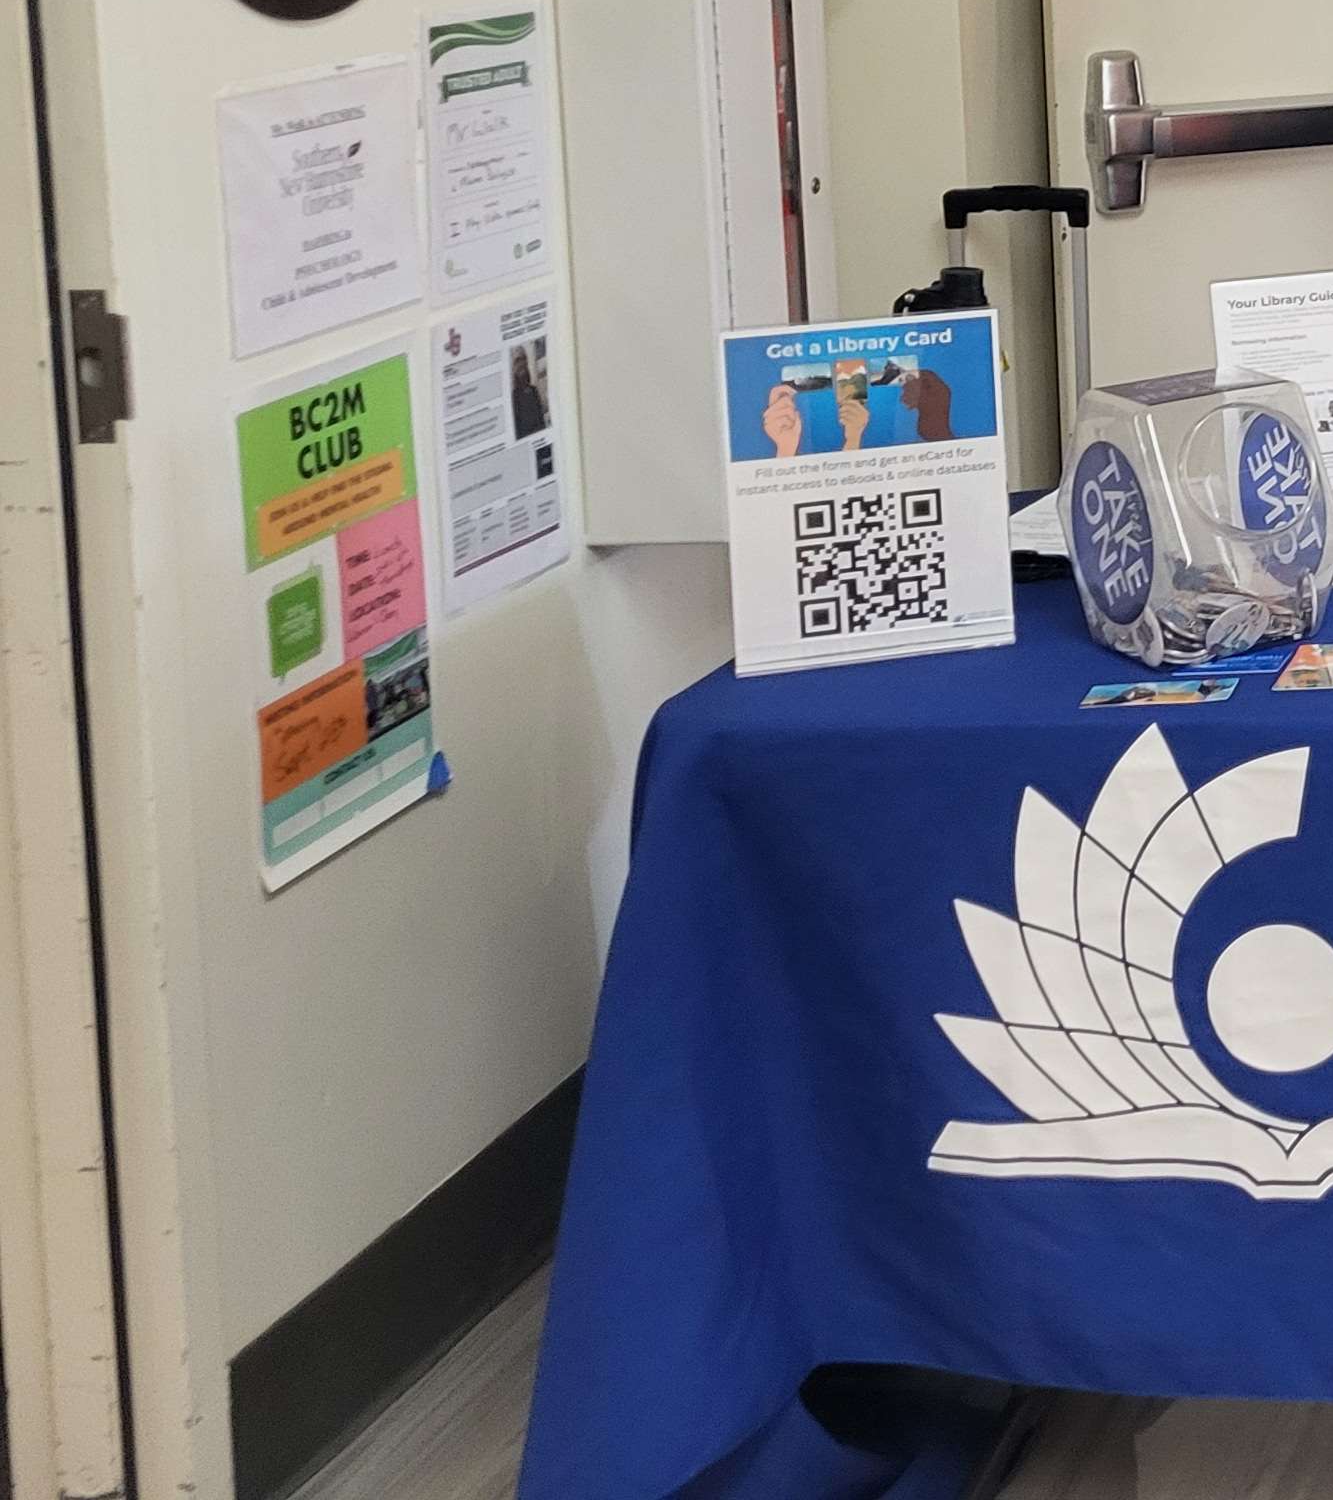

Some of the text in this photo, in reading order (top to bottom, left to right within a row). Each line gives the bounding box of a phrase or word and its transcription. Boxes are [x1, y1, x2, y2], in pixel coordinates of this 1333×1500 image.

[1227, 298, 1258, 310] Your
[1260, 293, 1306, 308] Library
[766, 327, 953, 360] Get a Library Card
[289, 382, 366, 441] BC2M
[297, 426, 363, 480] CLUB
[755, 446, 974, 479] Fill out the form and get an eCard for
[782, 479, 822, 492] access
[824, 476, 838, 488] to
[840, 471, 884, 486] eBooks
[897, 466, 934, 480] online
[936, 460, 996, 477] databases
[1082, 479, 1125, 607] ONE
[1097, 448, 1149, 597] TAKE
